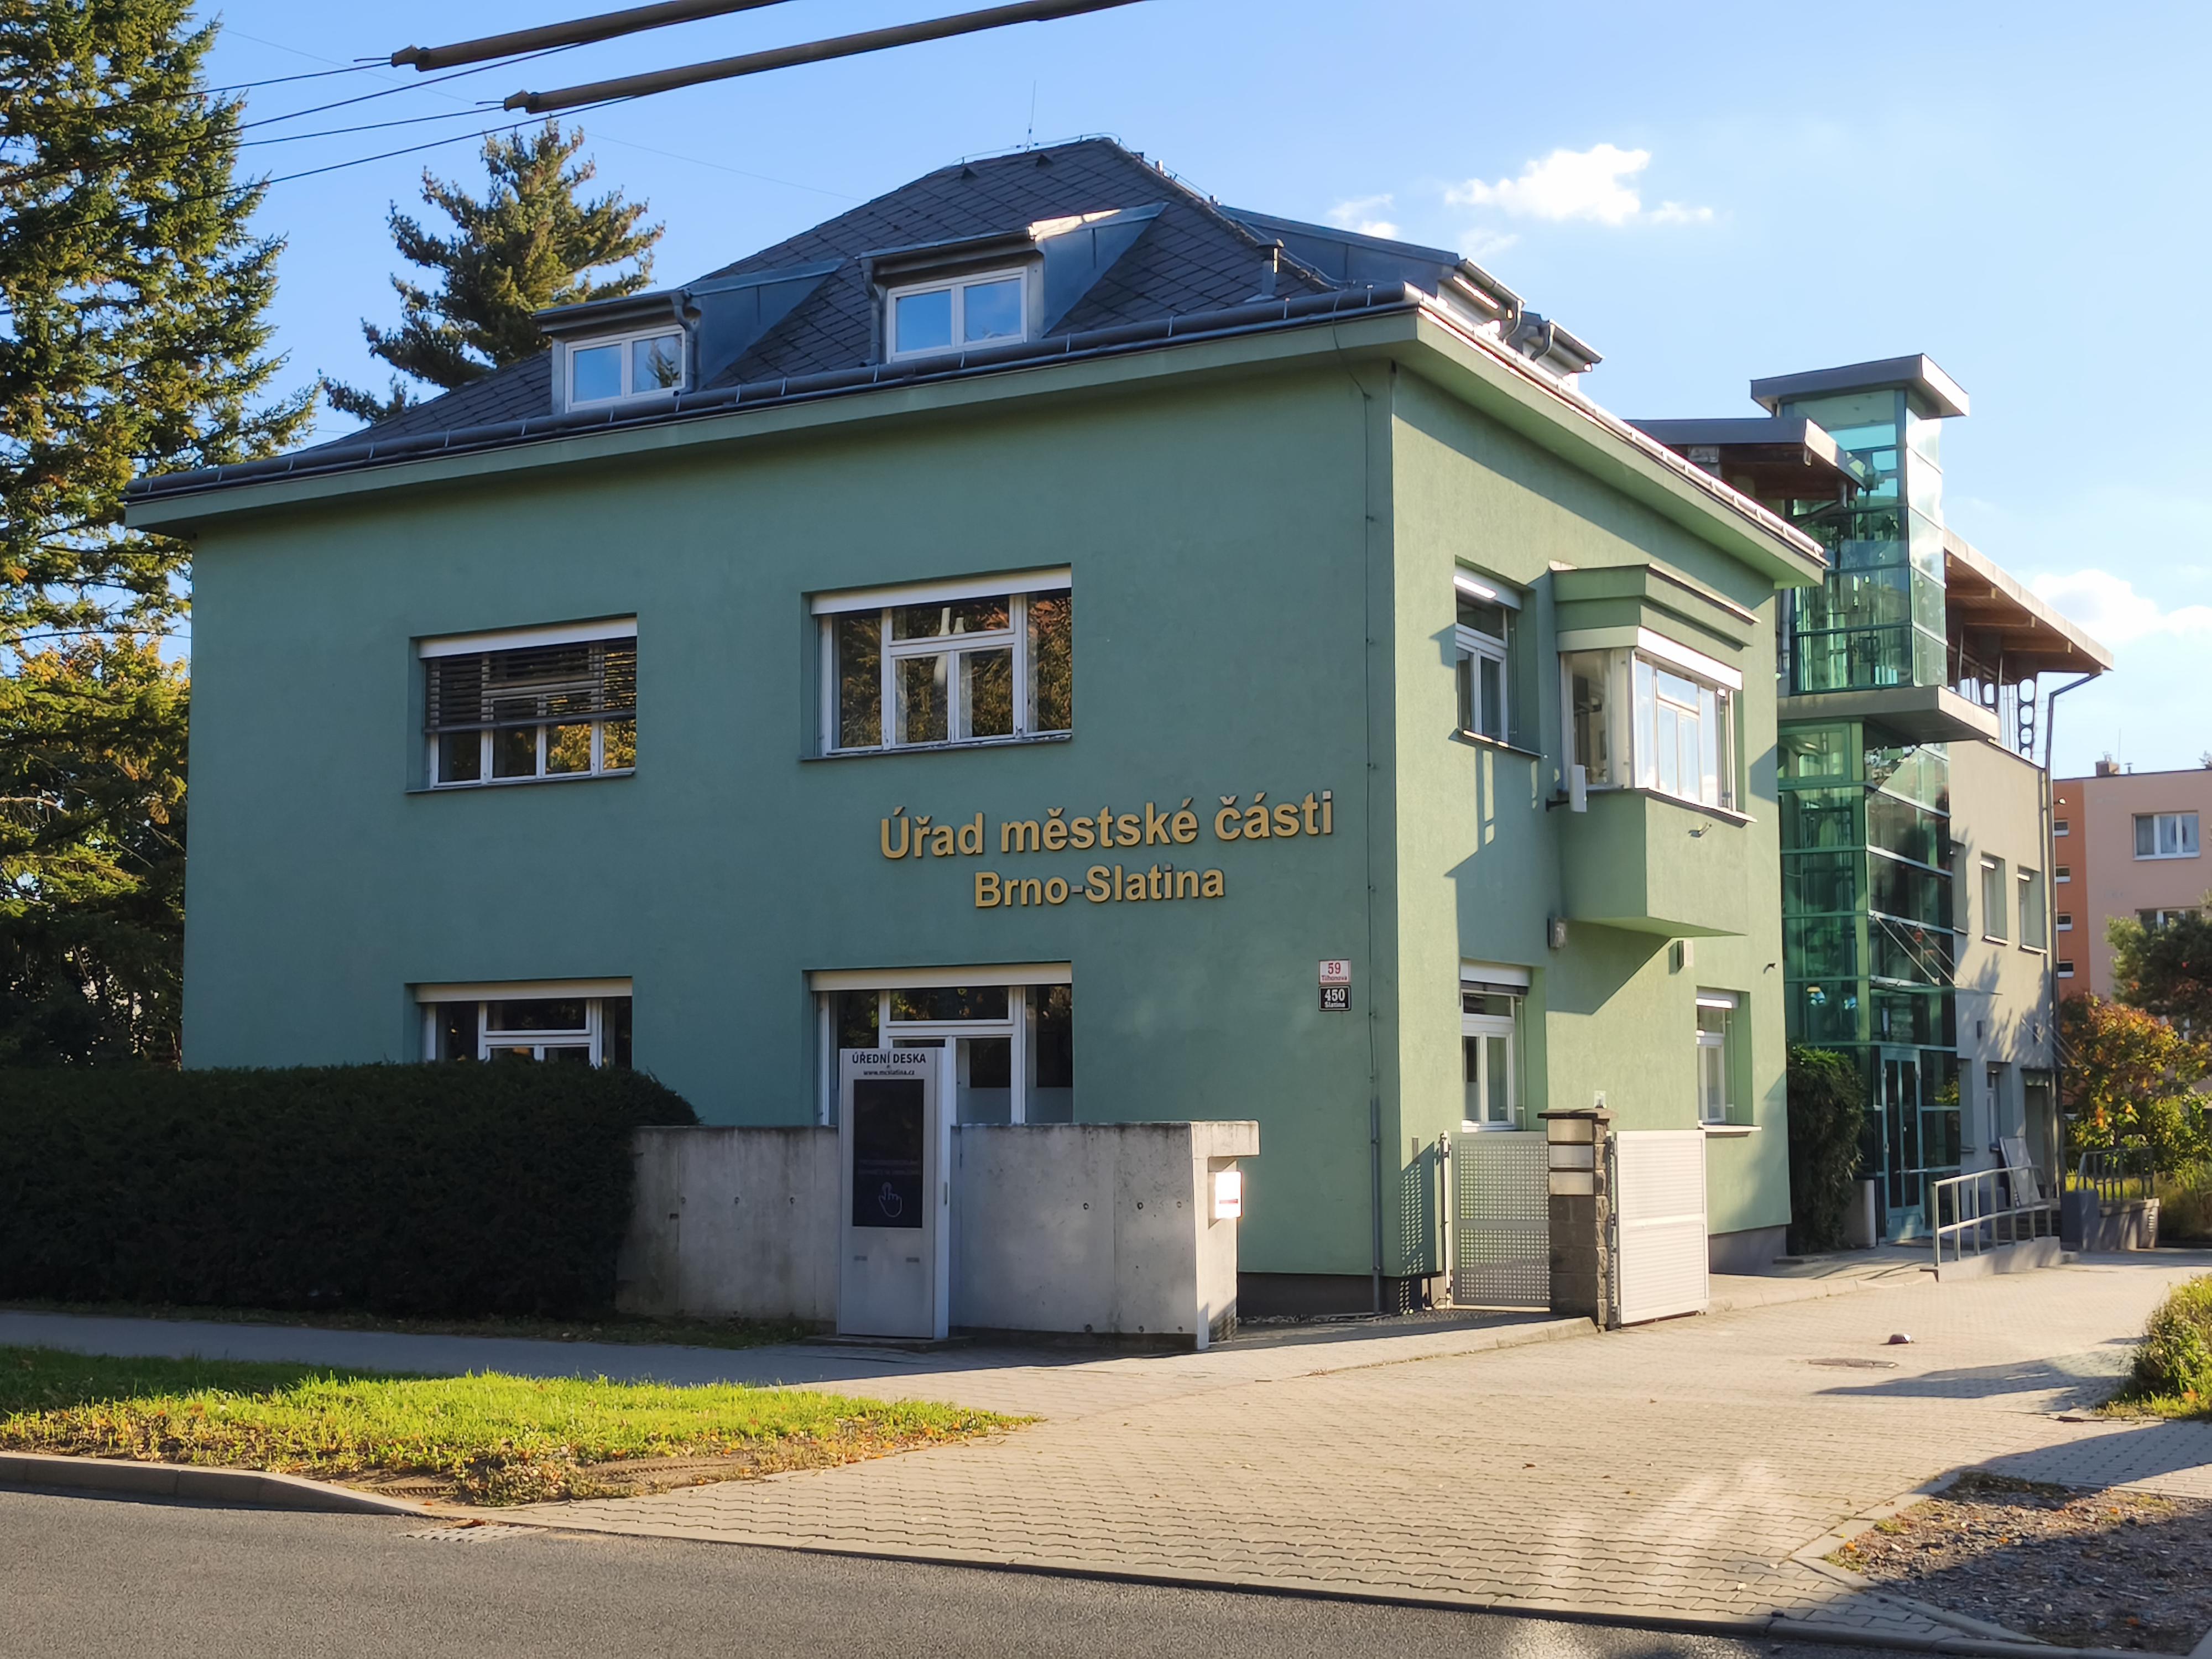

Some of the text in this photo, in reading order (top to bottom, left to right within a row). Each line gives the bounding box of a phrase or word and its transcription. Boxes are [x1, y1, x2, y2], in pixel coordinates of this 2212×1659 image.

[880, 789, 1333, 859] Úřad městské části
[974, 863, 1225, 907] Brno-Slatina
[1328, 962, 1341, 974] 59
[1324, 989, 1345, 1001] 450
[852, 1051, 927, 1064] ÚŘEDNÍ DESKA
